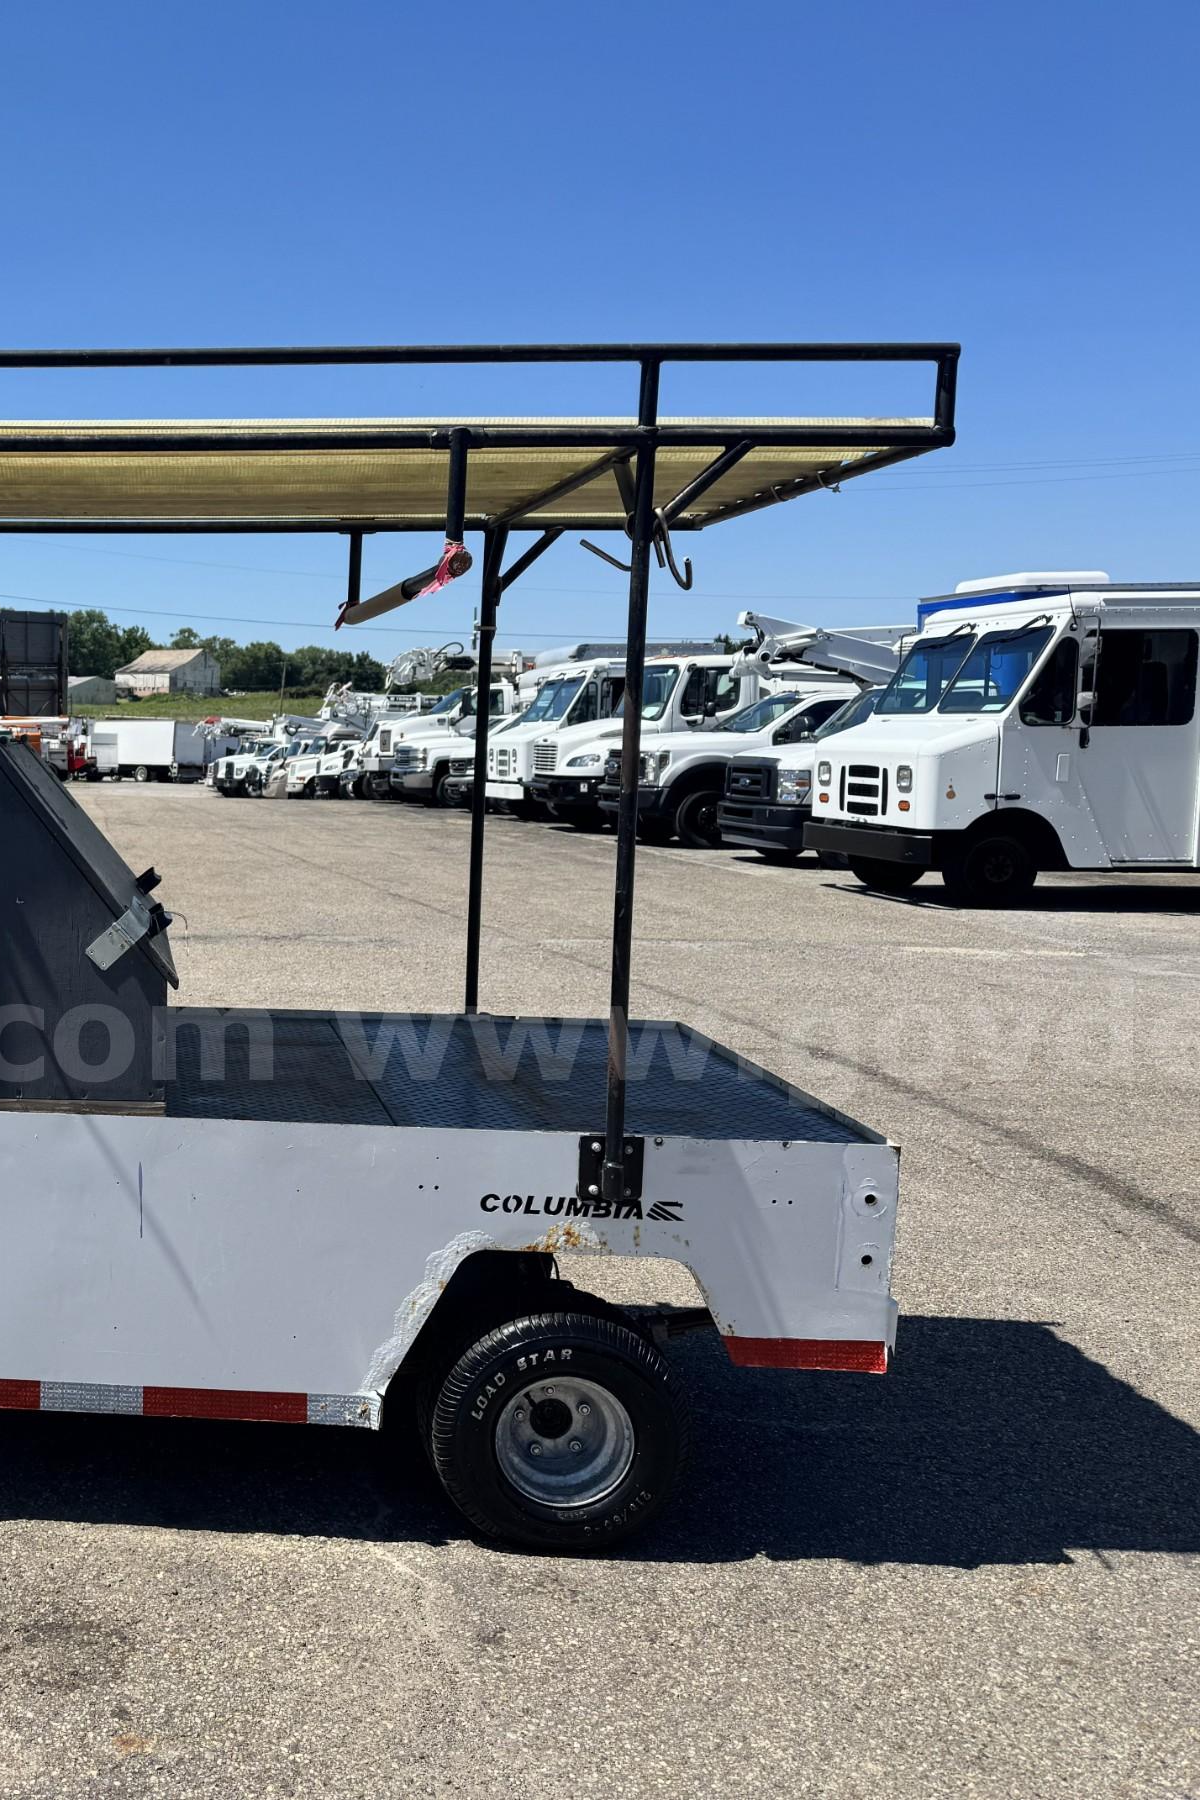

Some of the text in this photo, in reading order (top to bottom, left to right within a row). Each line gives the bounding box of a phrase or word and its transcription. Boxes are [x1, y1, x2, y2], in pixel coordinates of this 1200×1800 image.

[480, 1193, 643, 1220] COLUMBIA
[471, 1348, 574, 1421] LOAD STAR
